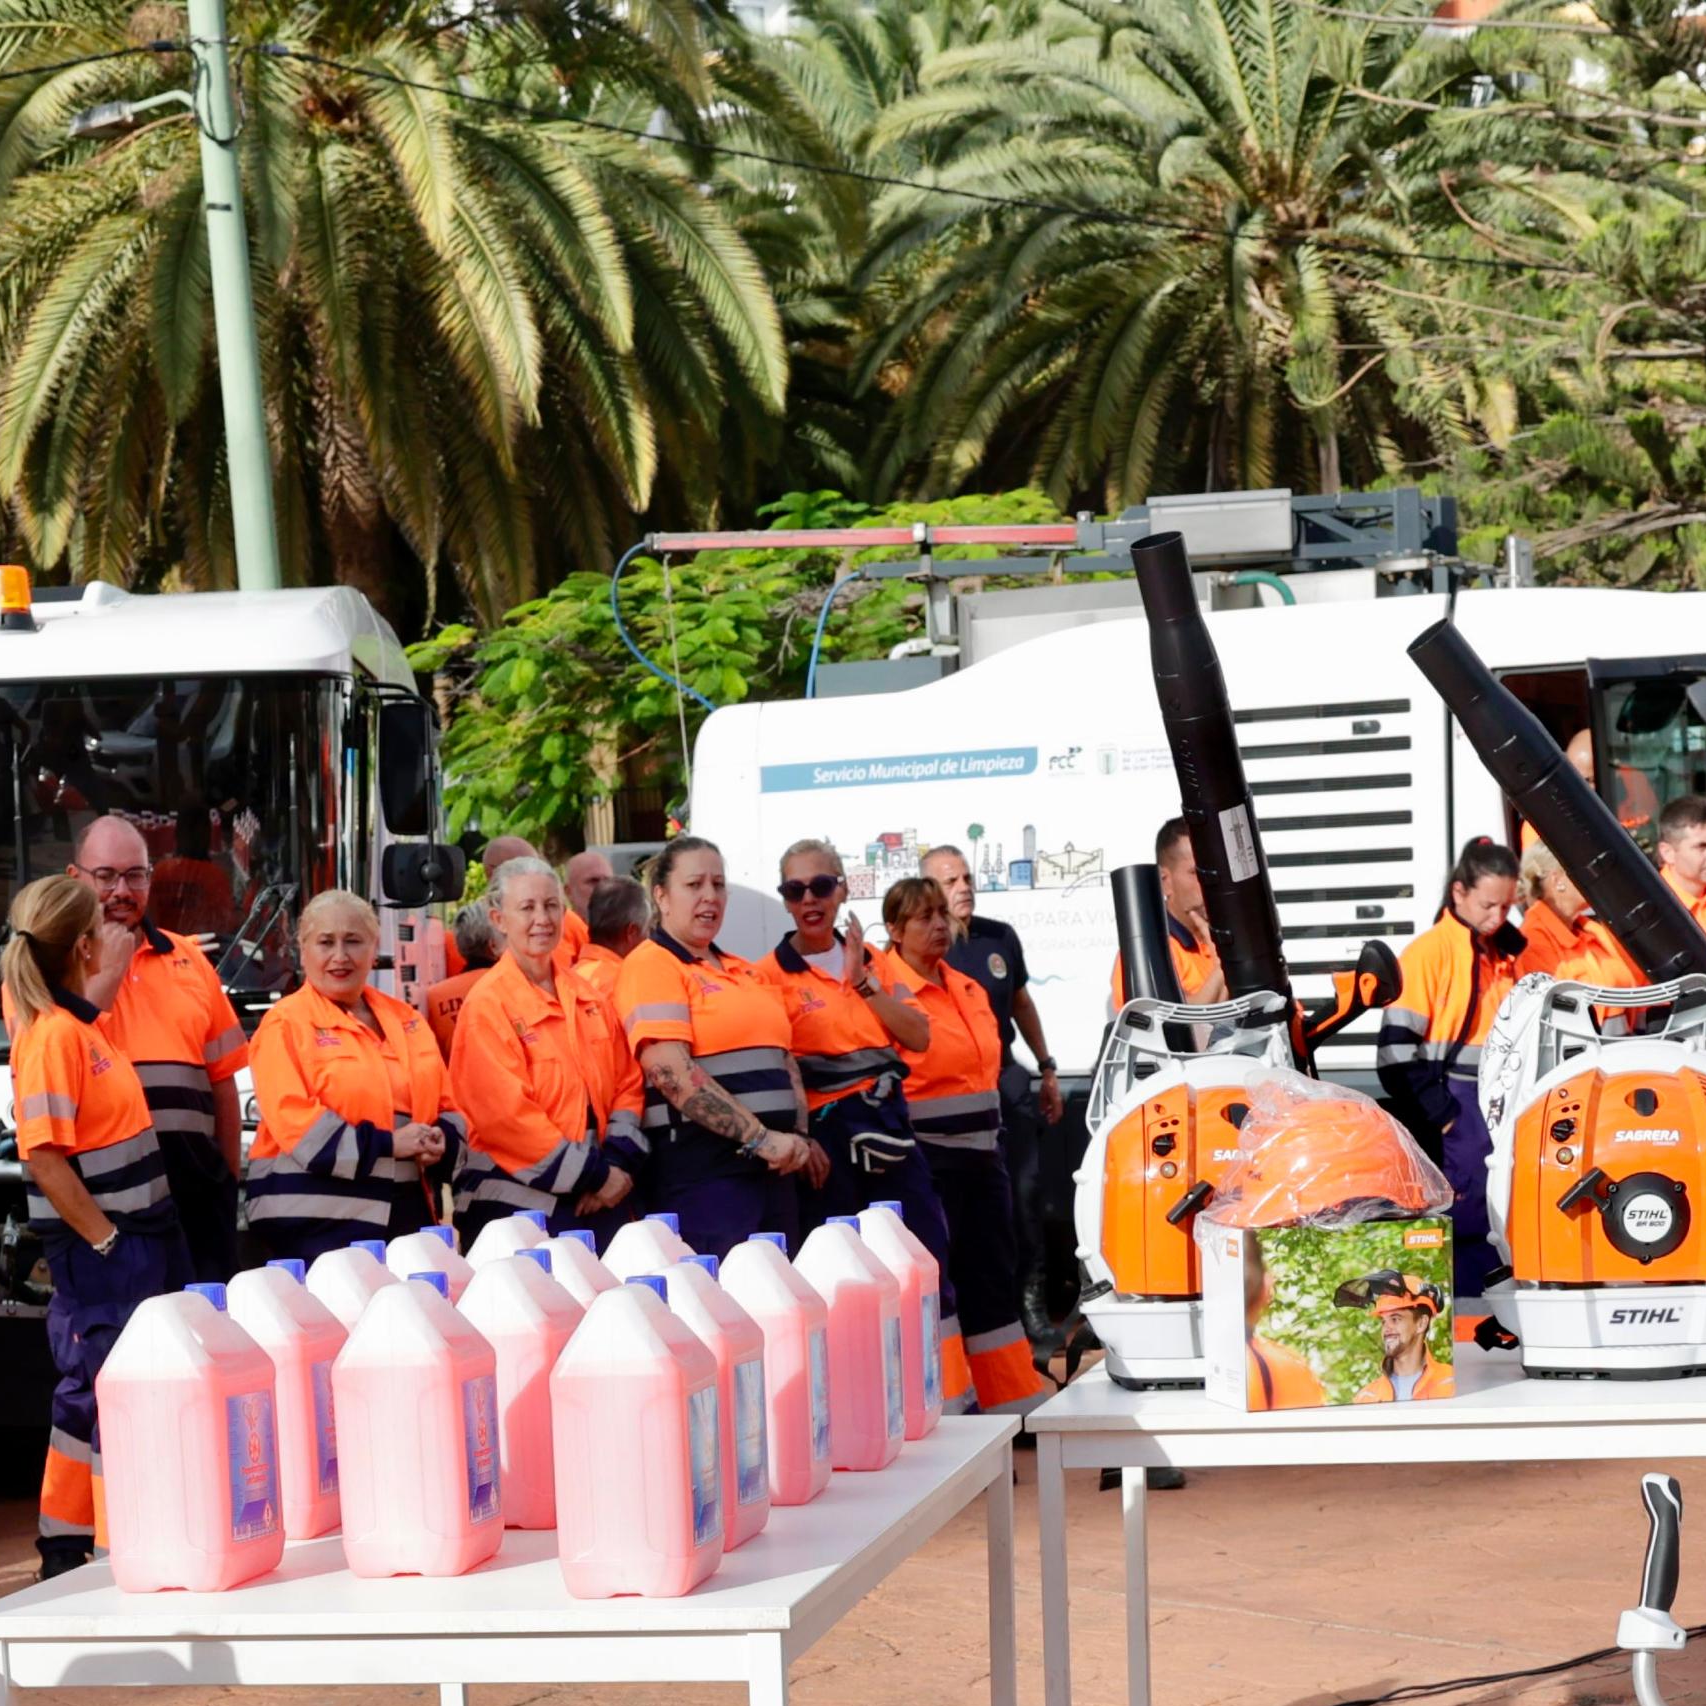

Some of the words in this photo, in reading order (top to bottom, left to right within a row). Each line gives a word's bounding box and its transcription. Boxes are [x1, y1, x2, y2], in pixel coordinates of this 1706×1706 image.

[813, 765, 867, 785] Servicio
[868, 759, 939, 782] Municipal
[940, 758, 958, 775] de
[960, 754, 1025, 776] Limpieza
[1614, 1129, 1681, 1143] SAGRERA
[1626, 1209, 1668, 1220] STIHL
[1408, 1233, 1439, 1246] STIHL
[1609, 1307, 1682, 1325] STIHL
